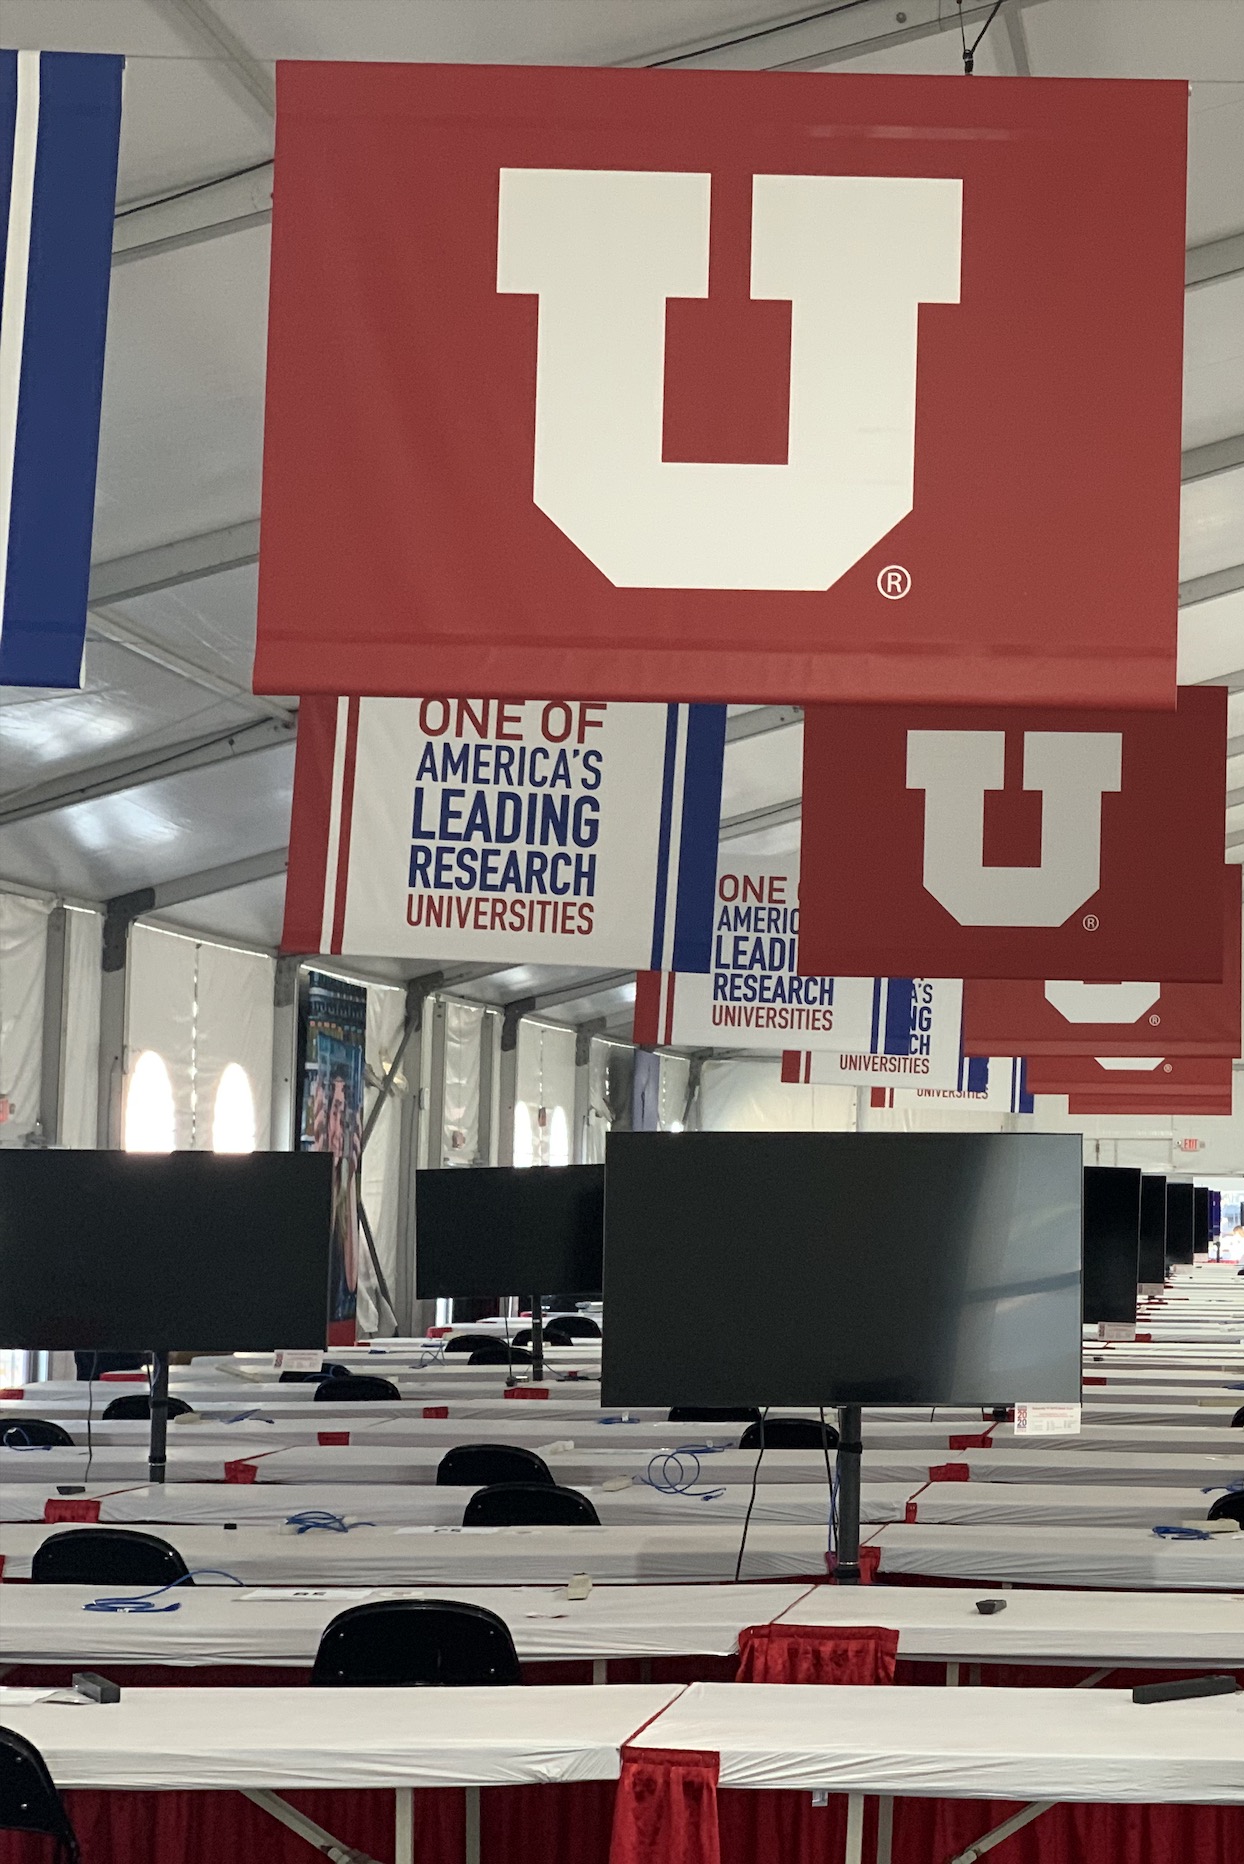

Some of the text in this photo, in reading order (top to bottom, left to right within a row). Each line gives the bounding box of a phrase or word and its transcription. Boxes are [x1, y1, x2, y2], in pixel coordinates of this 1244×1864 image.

[497, 168, 963, 591] U
[418, 698, 608, 745] ONE OF
[415, 741, 603, 791] AMERICA'S
[410, 786, 601, 849] LEADING
[906, 730, 1122, 927] U
[408, 845, 597, 897] RESEARCH
[718, 874, 788, 905] ONE
[406, 894, 595, 936] UNIVERSITIES
[717, 905, 799, 934] AMERIC
[715, 934, 796, 973] LEADI
[713, 972, 835, 1006] RESEARCH
[711, 1004, 833, 1031] UNIVERSITIES
[839, 1053, 930, 1075] UNIVERSITIES
